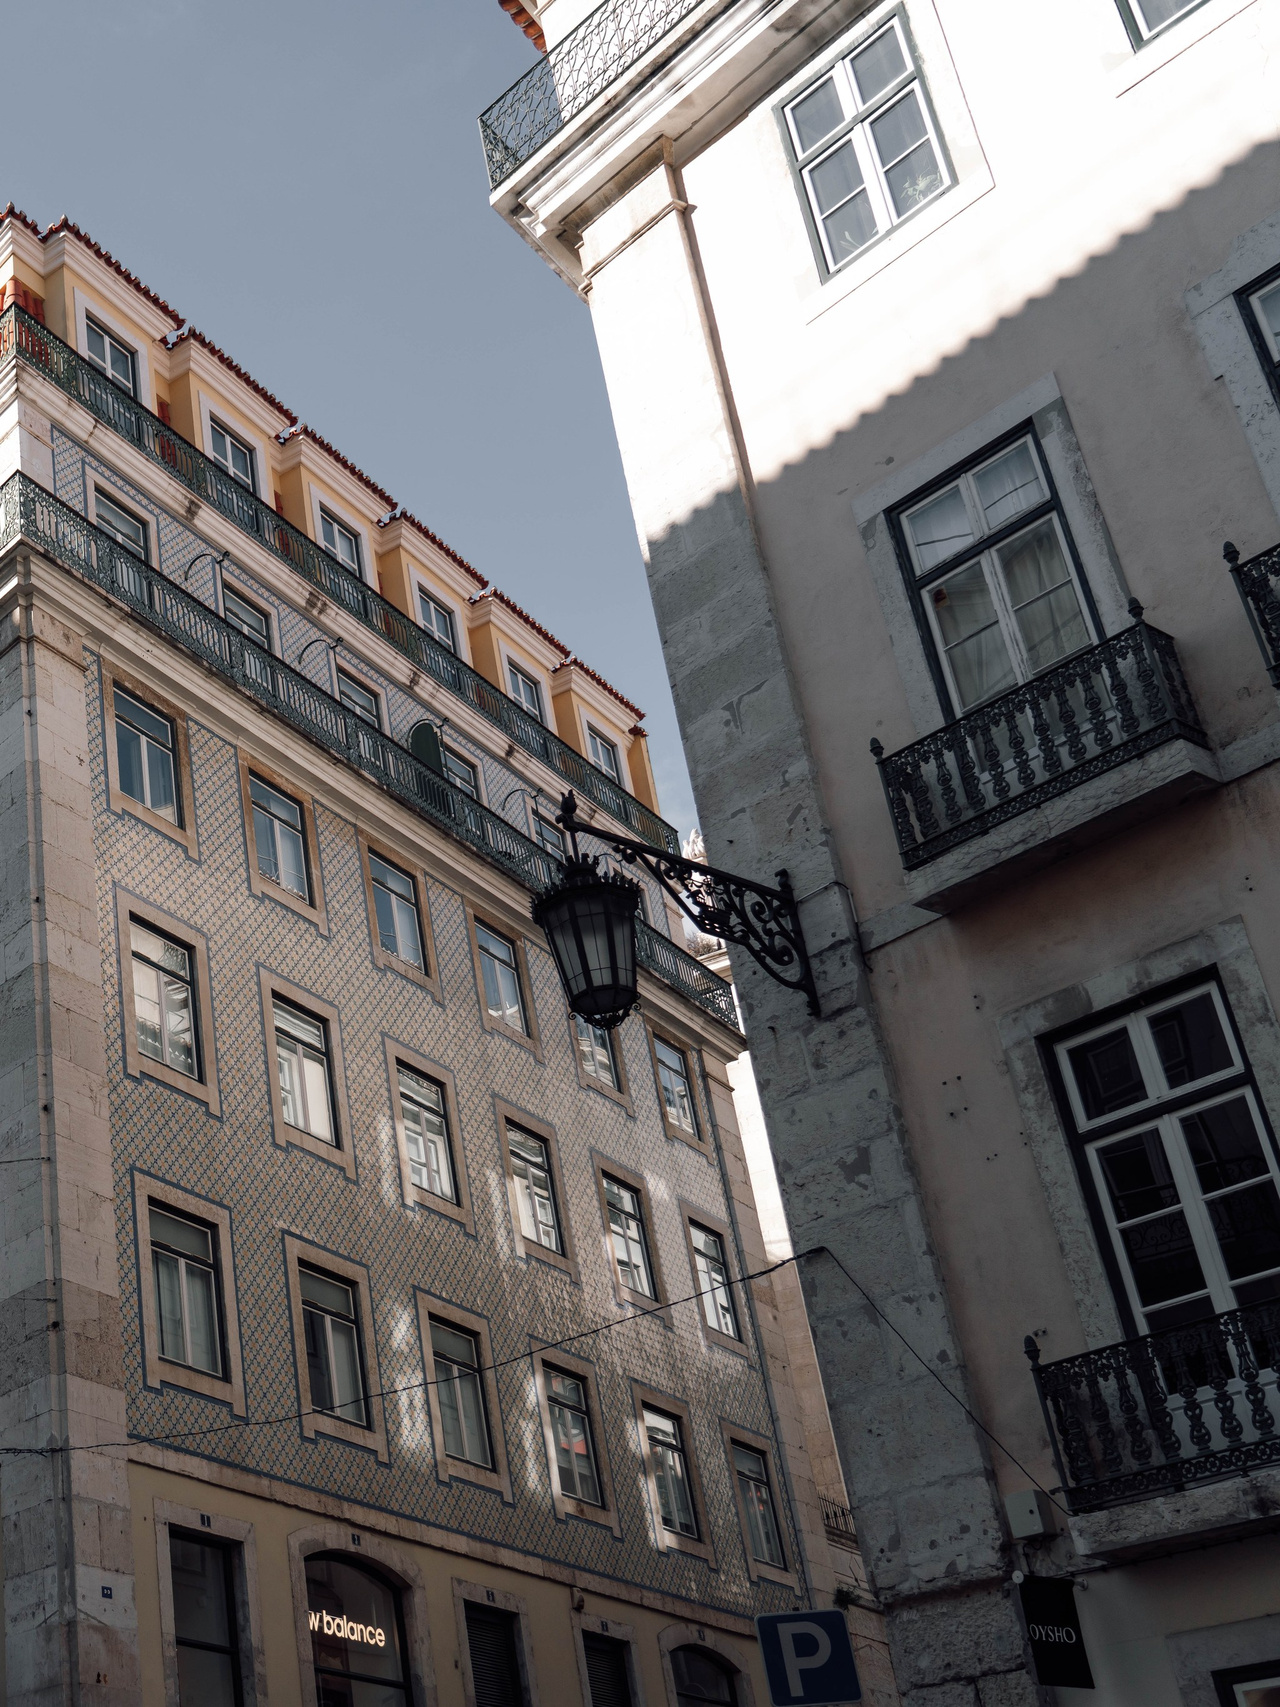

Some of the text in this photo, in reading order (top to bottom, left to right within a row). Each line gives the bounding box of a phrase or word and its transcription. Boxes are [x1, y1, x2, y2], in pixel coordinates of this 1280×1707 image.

[322, 1609, 386, 1648] balance
[1029, 1623, 1076, 1644] OYSHO
[776, 1621, 832, 1697] P
